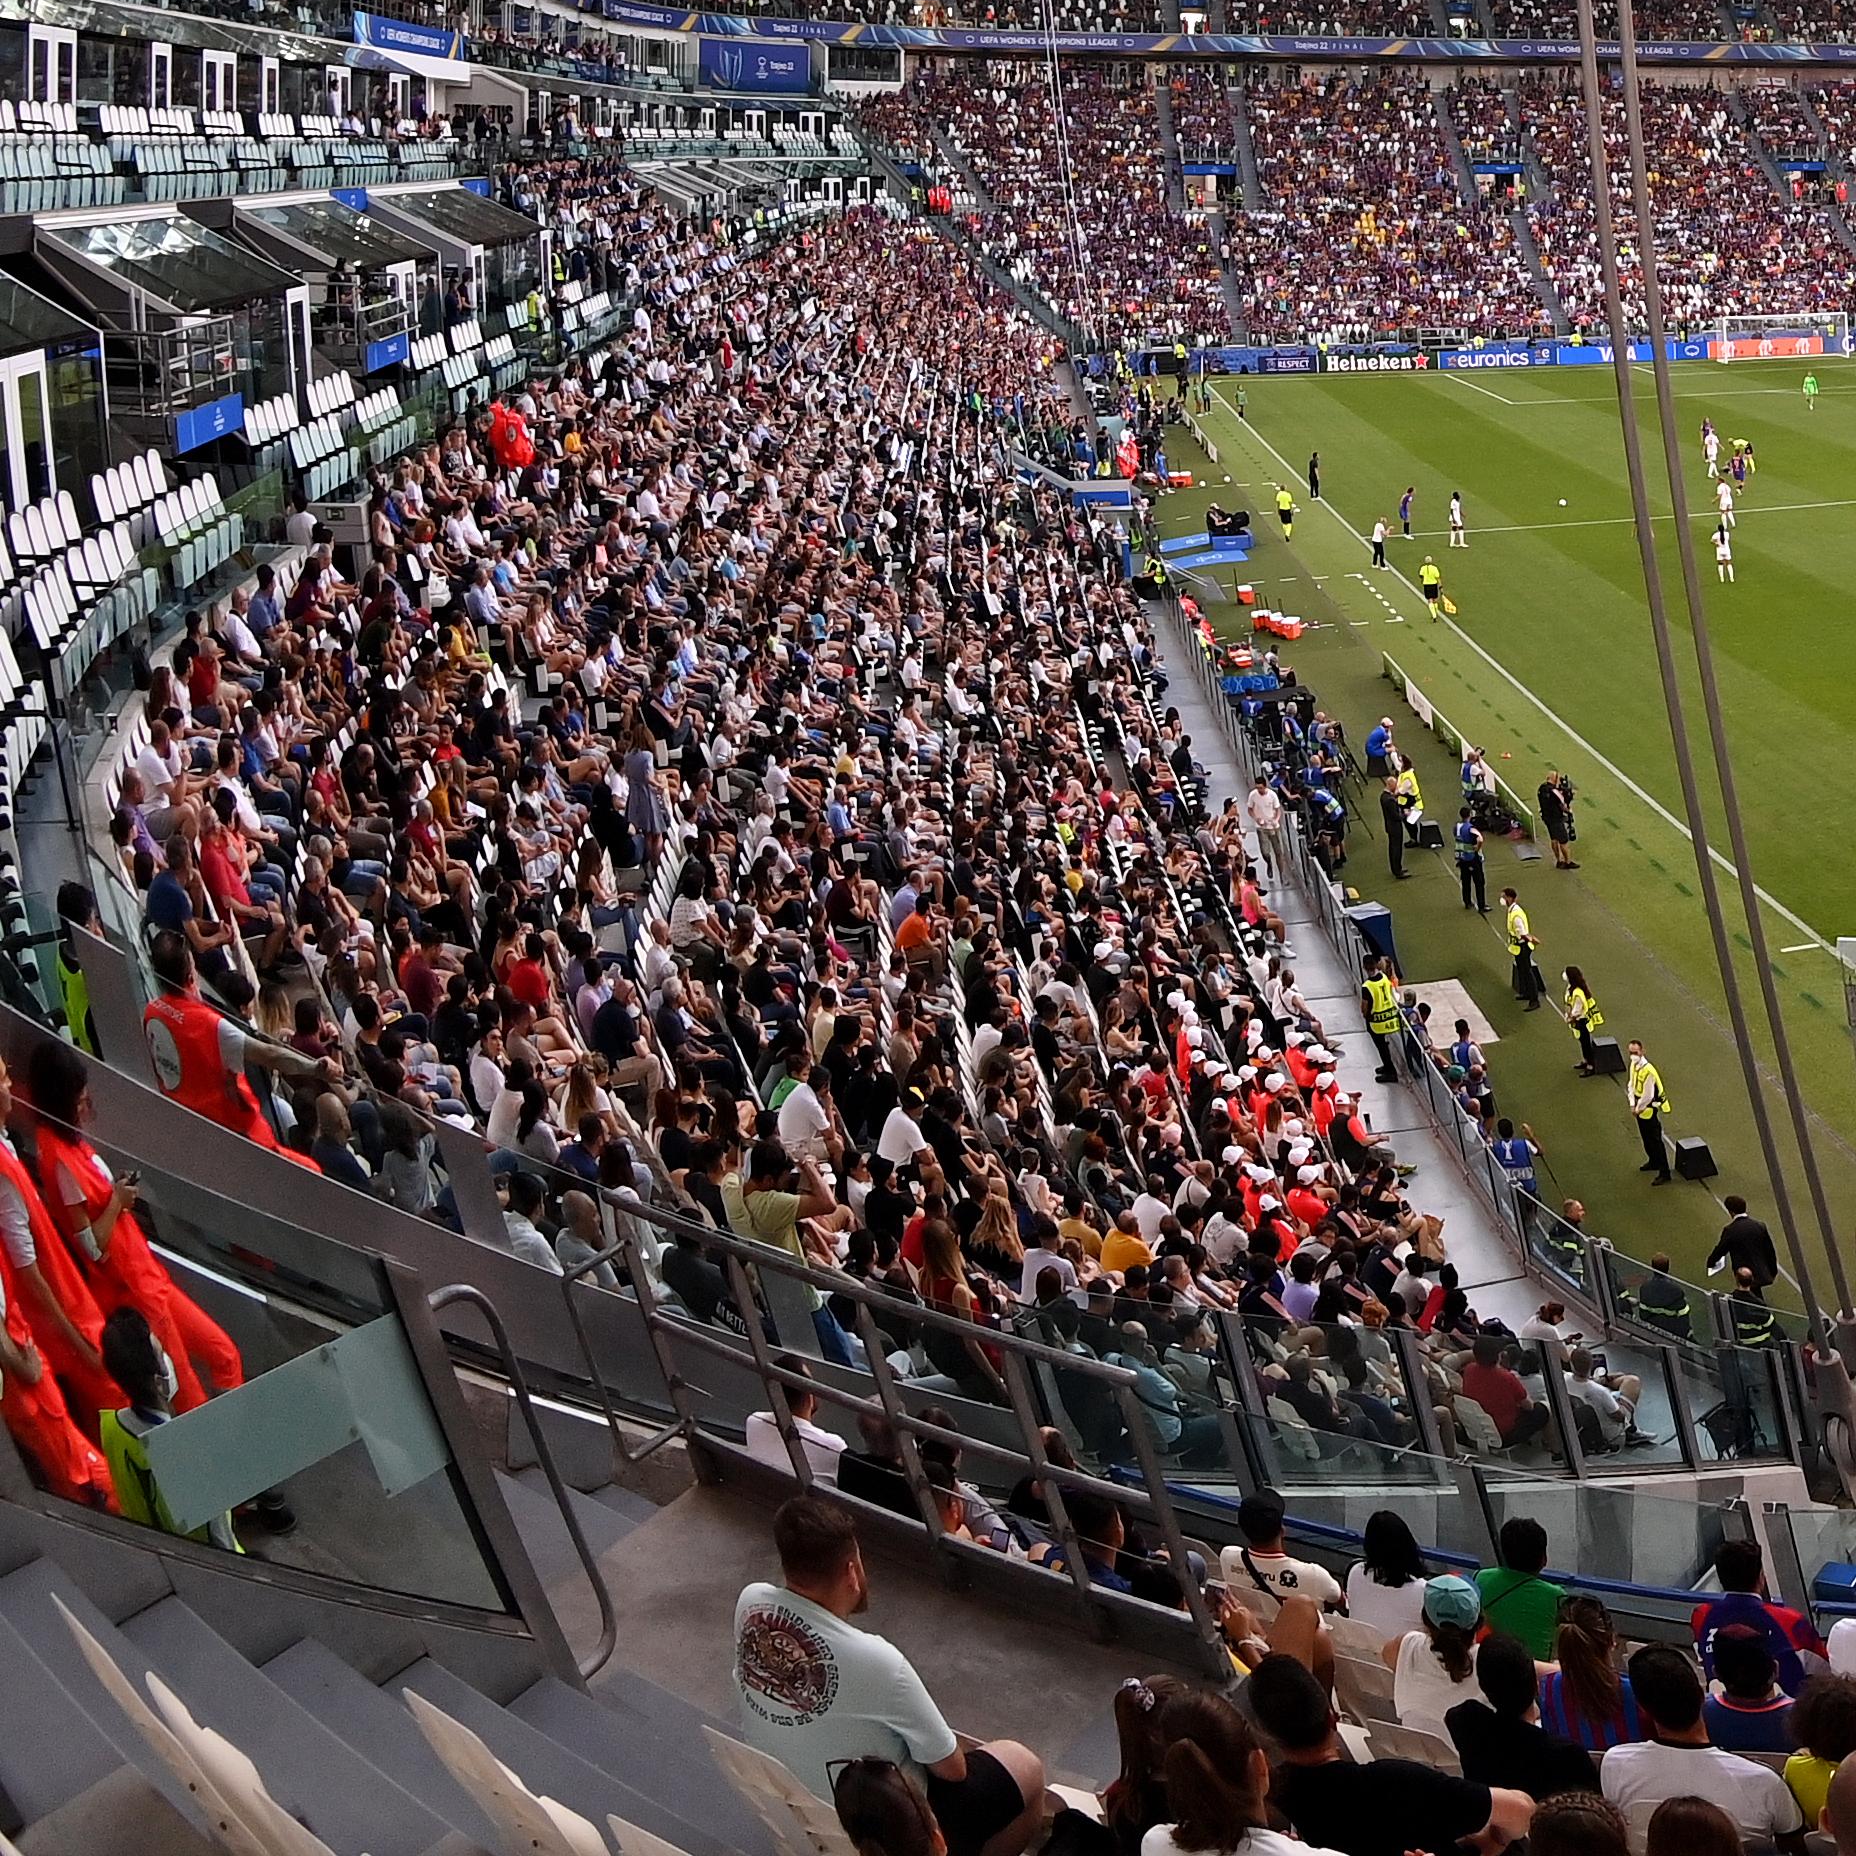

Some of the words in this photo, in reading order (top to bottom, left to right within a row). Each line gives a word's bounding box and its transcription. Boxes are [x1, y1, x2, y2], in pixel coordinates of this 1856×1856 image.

[980, 36, 997, 44] UEFA
[1088, 38, 1118, 47] LEAGUE
[1333, 42, 1363, 50] FINAL
[1537, 45, 1556, 53] UEFA
[1645, 47, 1673, 56] LEAGUE
[1277, 358, 1309, 369] RESPECT
[1326, 355, 1413, 371] Heineken
[1457, 352, 1529, 368] euronics
